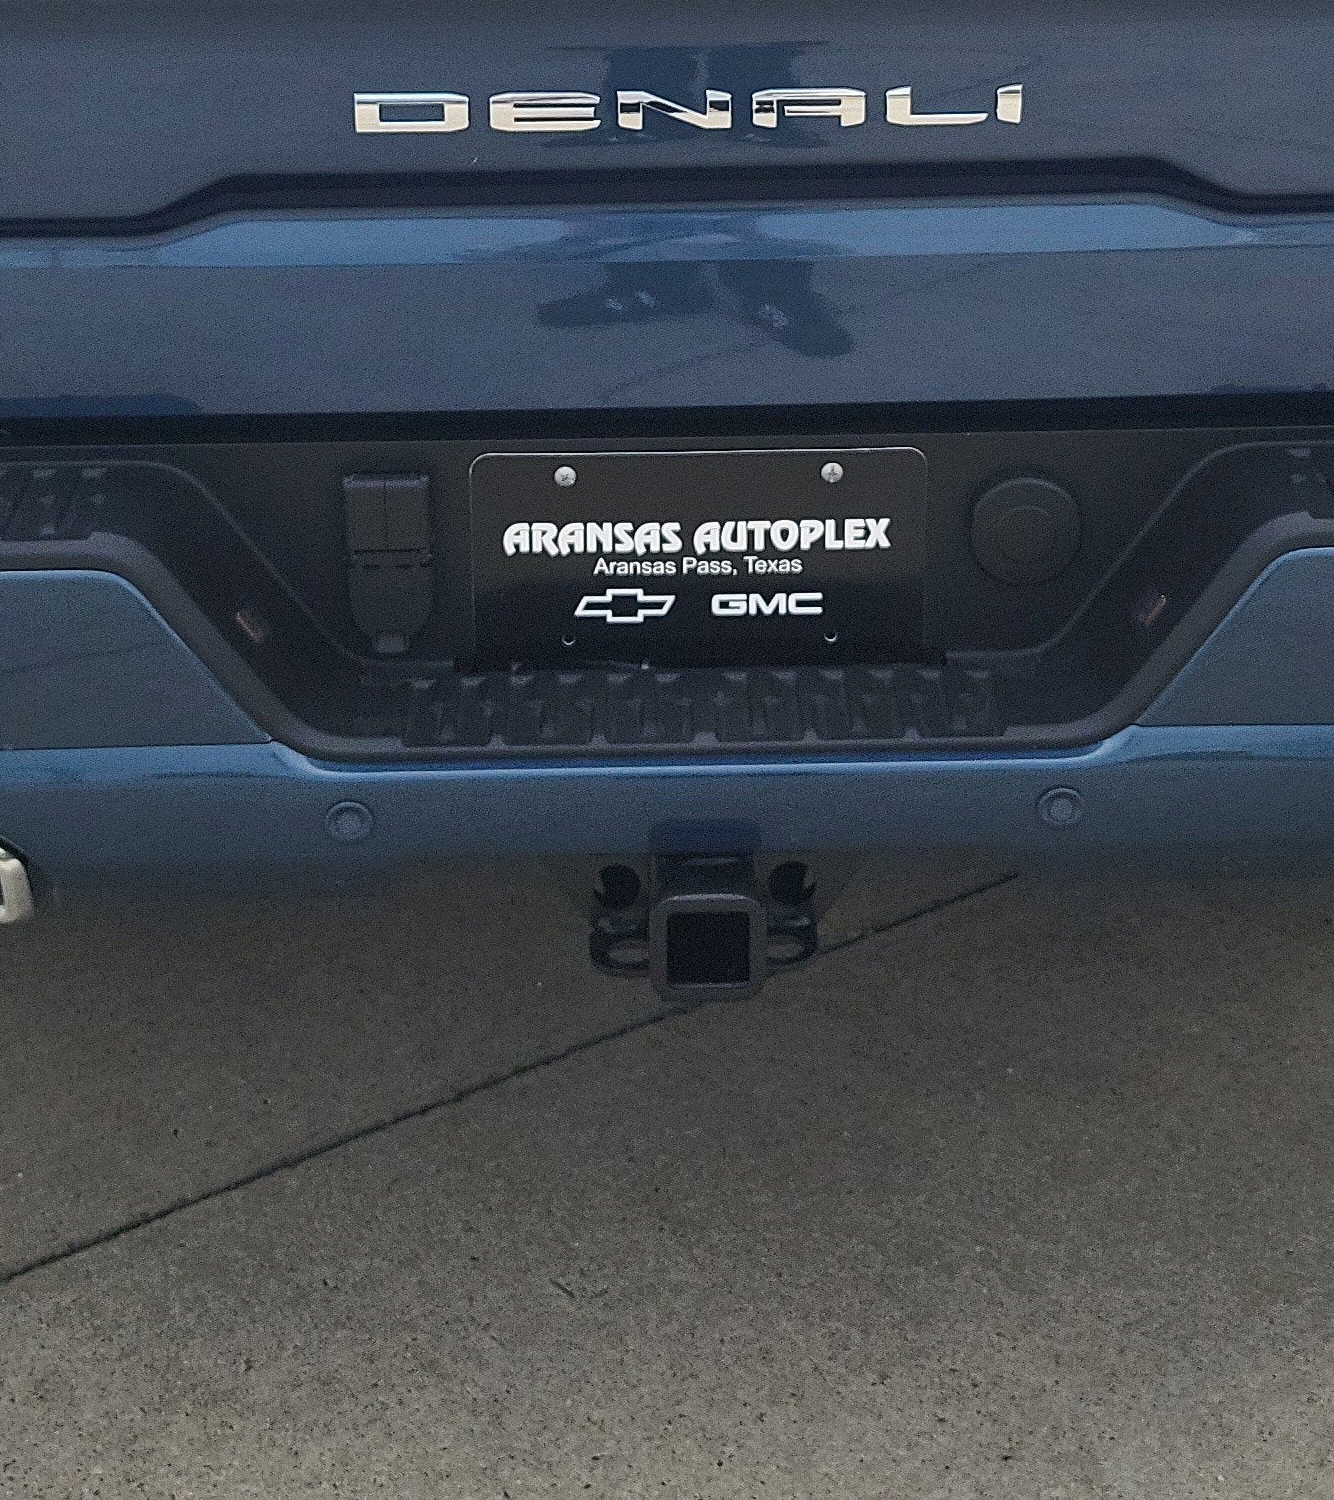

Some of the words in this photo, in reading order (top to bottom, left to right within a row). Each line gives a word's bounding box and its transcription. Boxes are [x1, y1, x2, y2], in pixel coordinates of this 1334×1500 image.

[354, 83, 1023, 134] DENALI
[502, 521, 683, 557] ARANSAS
[693, 518, 892, 556] AUTOPLEX
[593, 557, 677, 576] Aransas
[682, 556, 738, 577] Pass,
[744, 554, 803, 575] Texas
[710, 592, 824, 617] GMC
